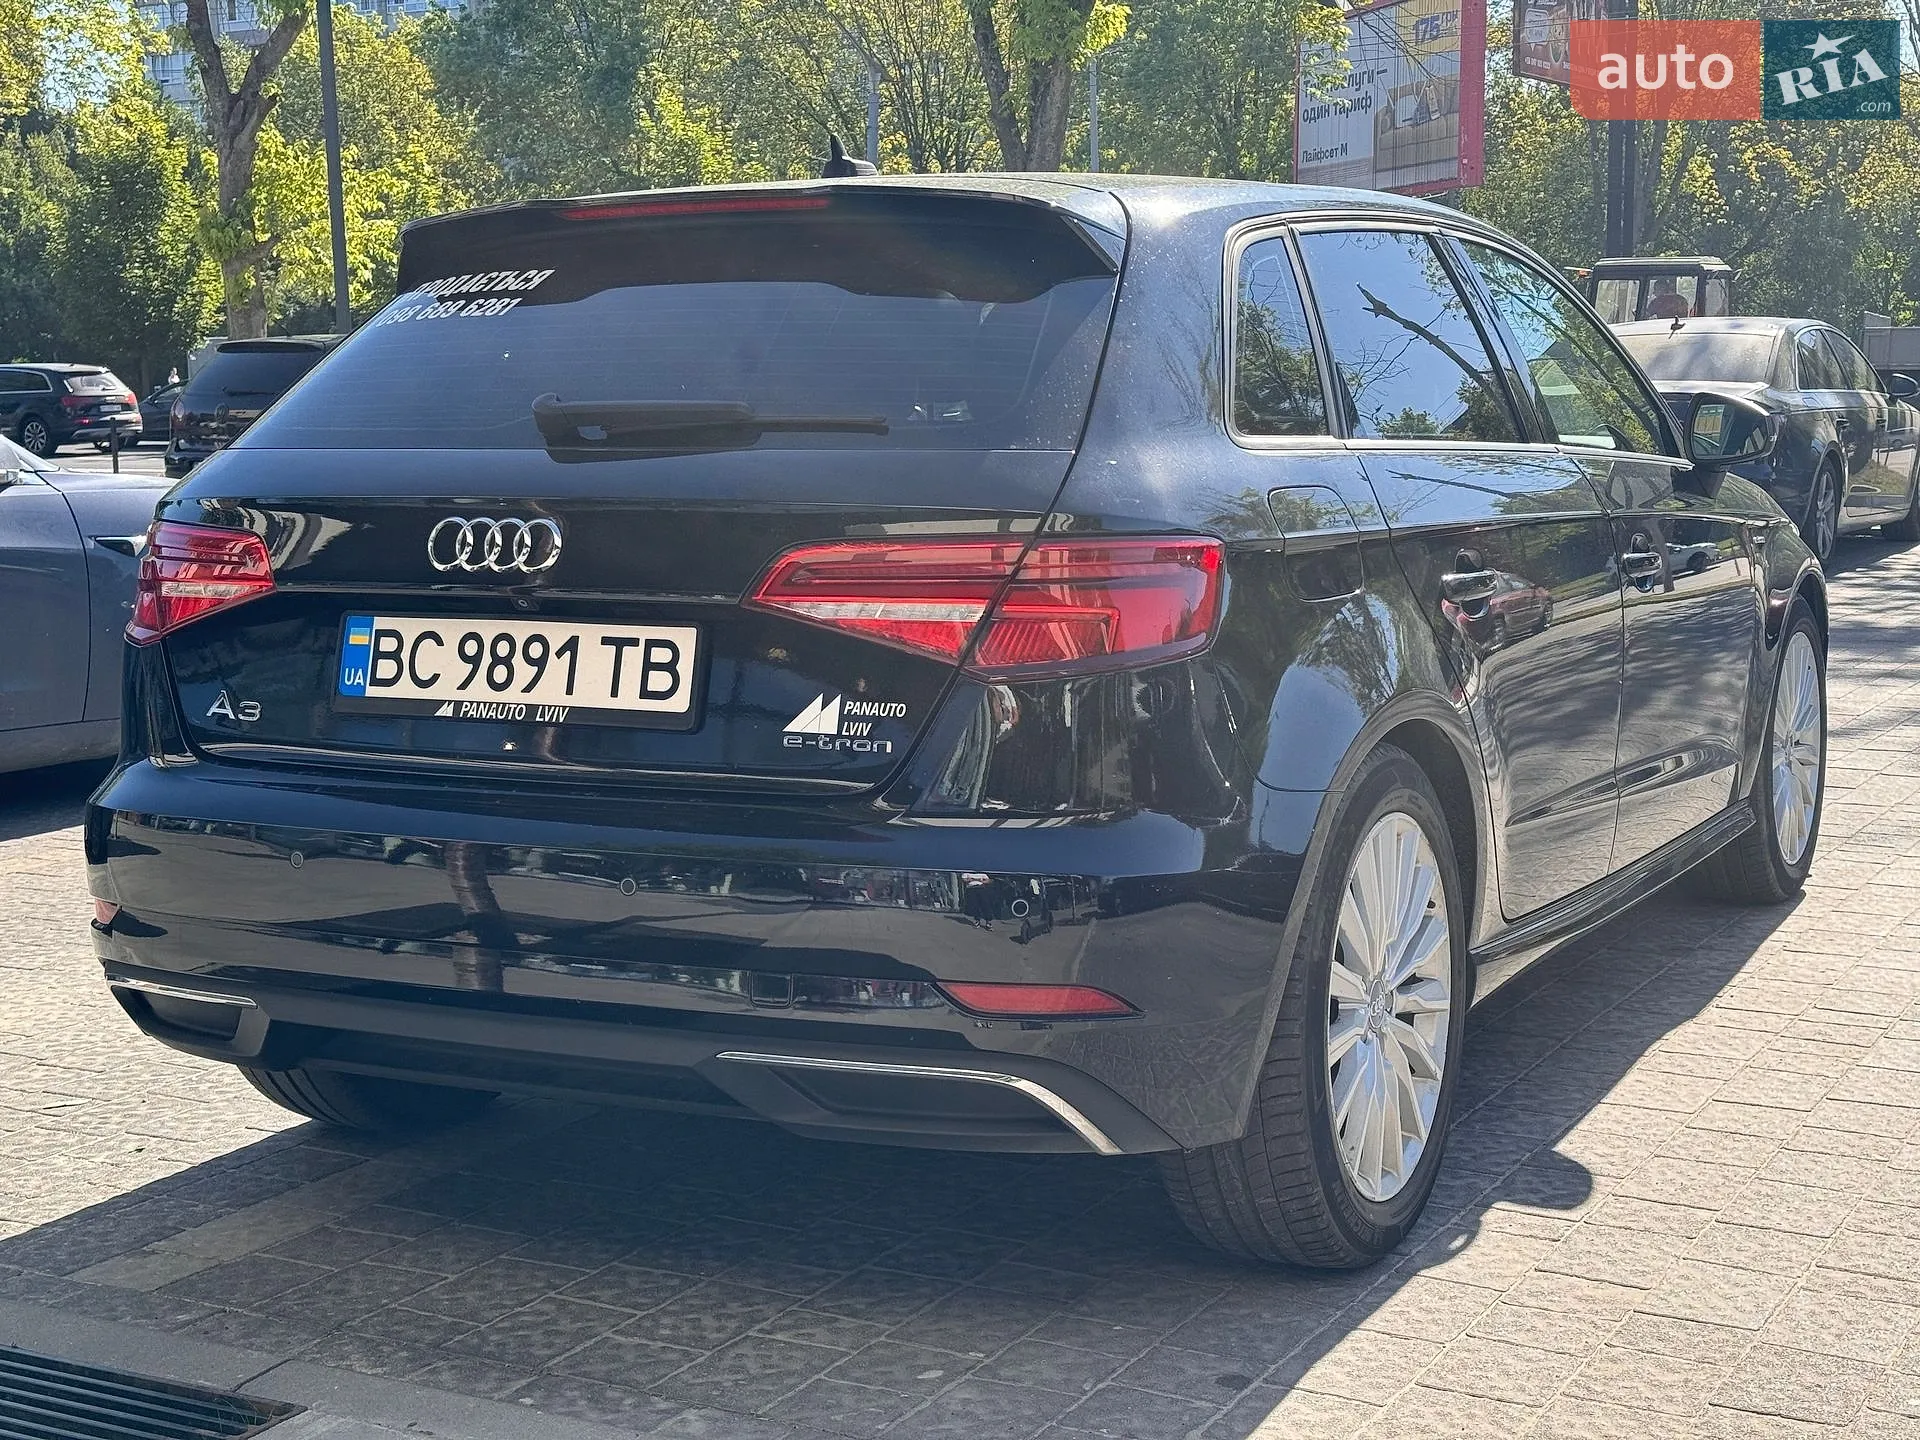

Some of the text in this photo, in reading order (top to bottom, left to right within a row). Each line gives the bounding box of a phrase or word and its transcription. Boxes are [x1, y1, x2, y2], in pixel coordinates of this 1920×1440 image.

[1302, 90, 1372, 123] один тариф
[1301, 147, 1339, 163] Лайфсет
[375, 298, 523, 327] 098 689 6281
[369, 629, 681, 701] BC 9891 TB
[344, 667, 365, 686] UA
[206, 690, 261, 721] A3
[459, 702, 570, 722] PANAUTO LVIV
[844, 701, 907, 717] PANAUTO
[842, 722, 872, 736] LVIV
[783, 735, 892, 753] e-tron
